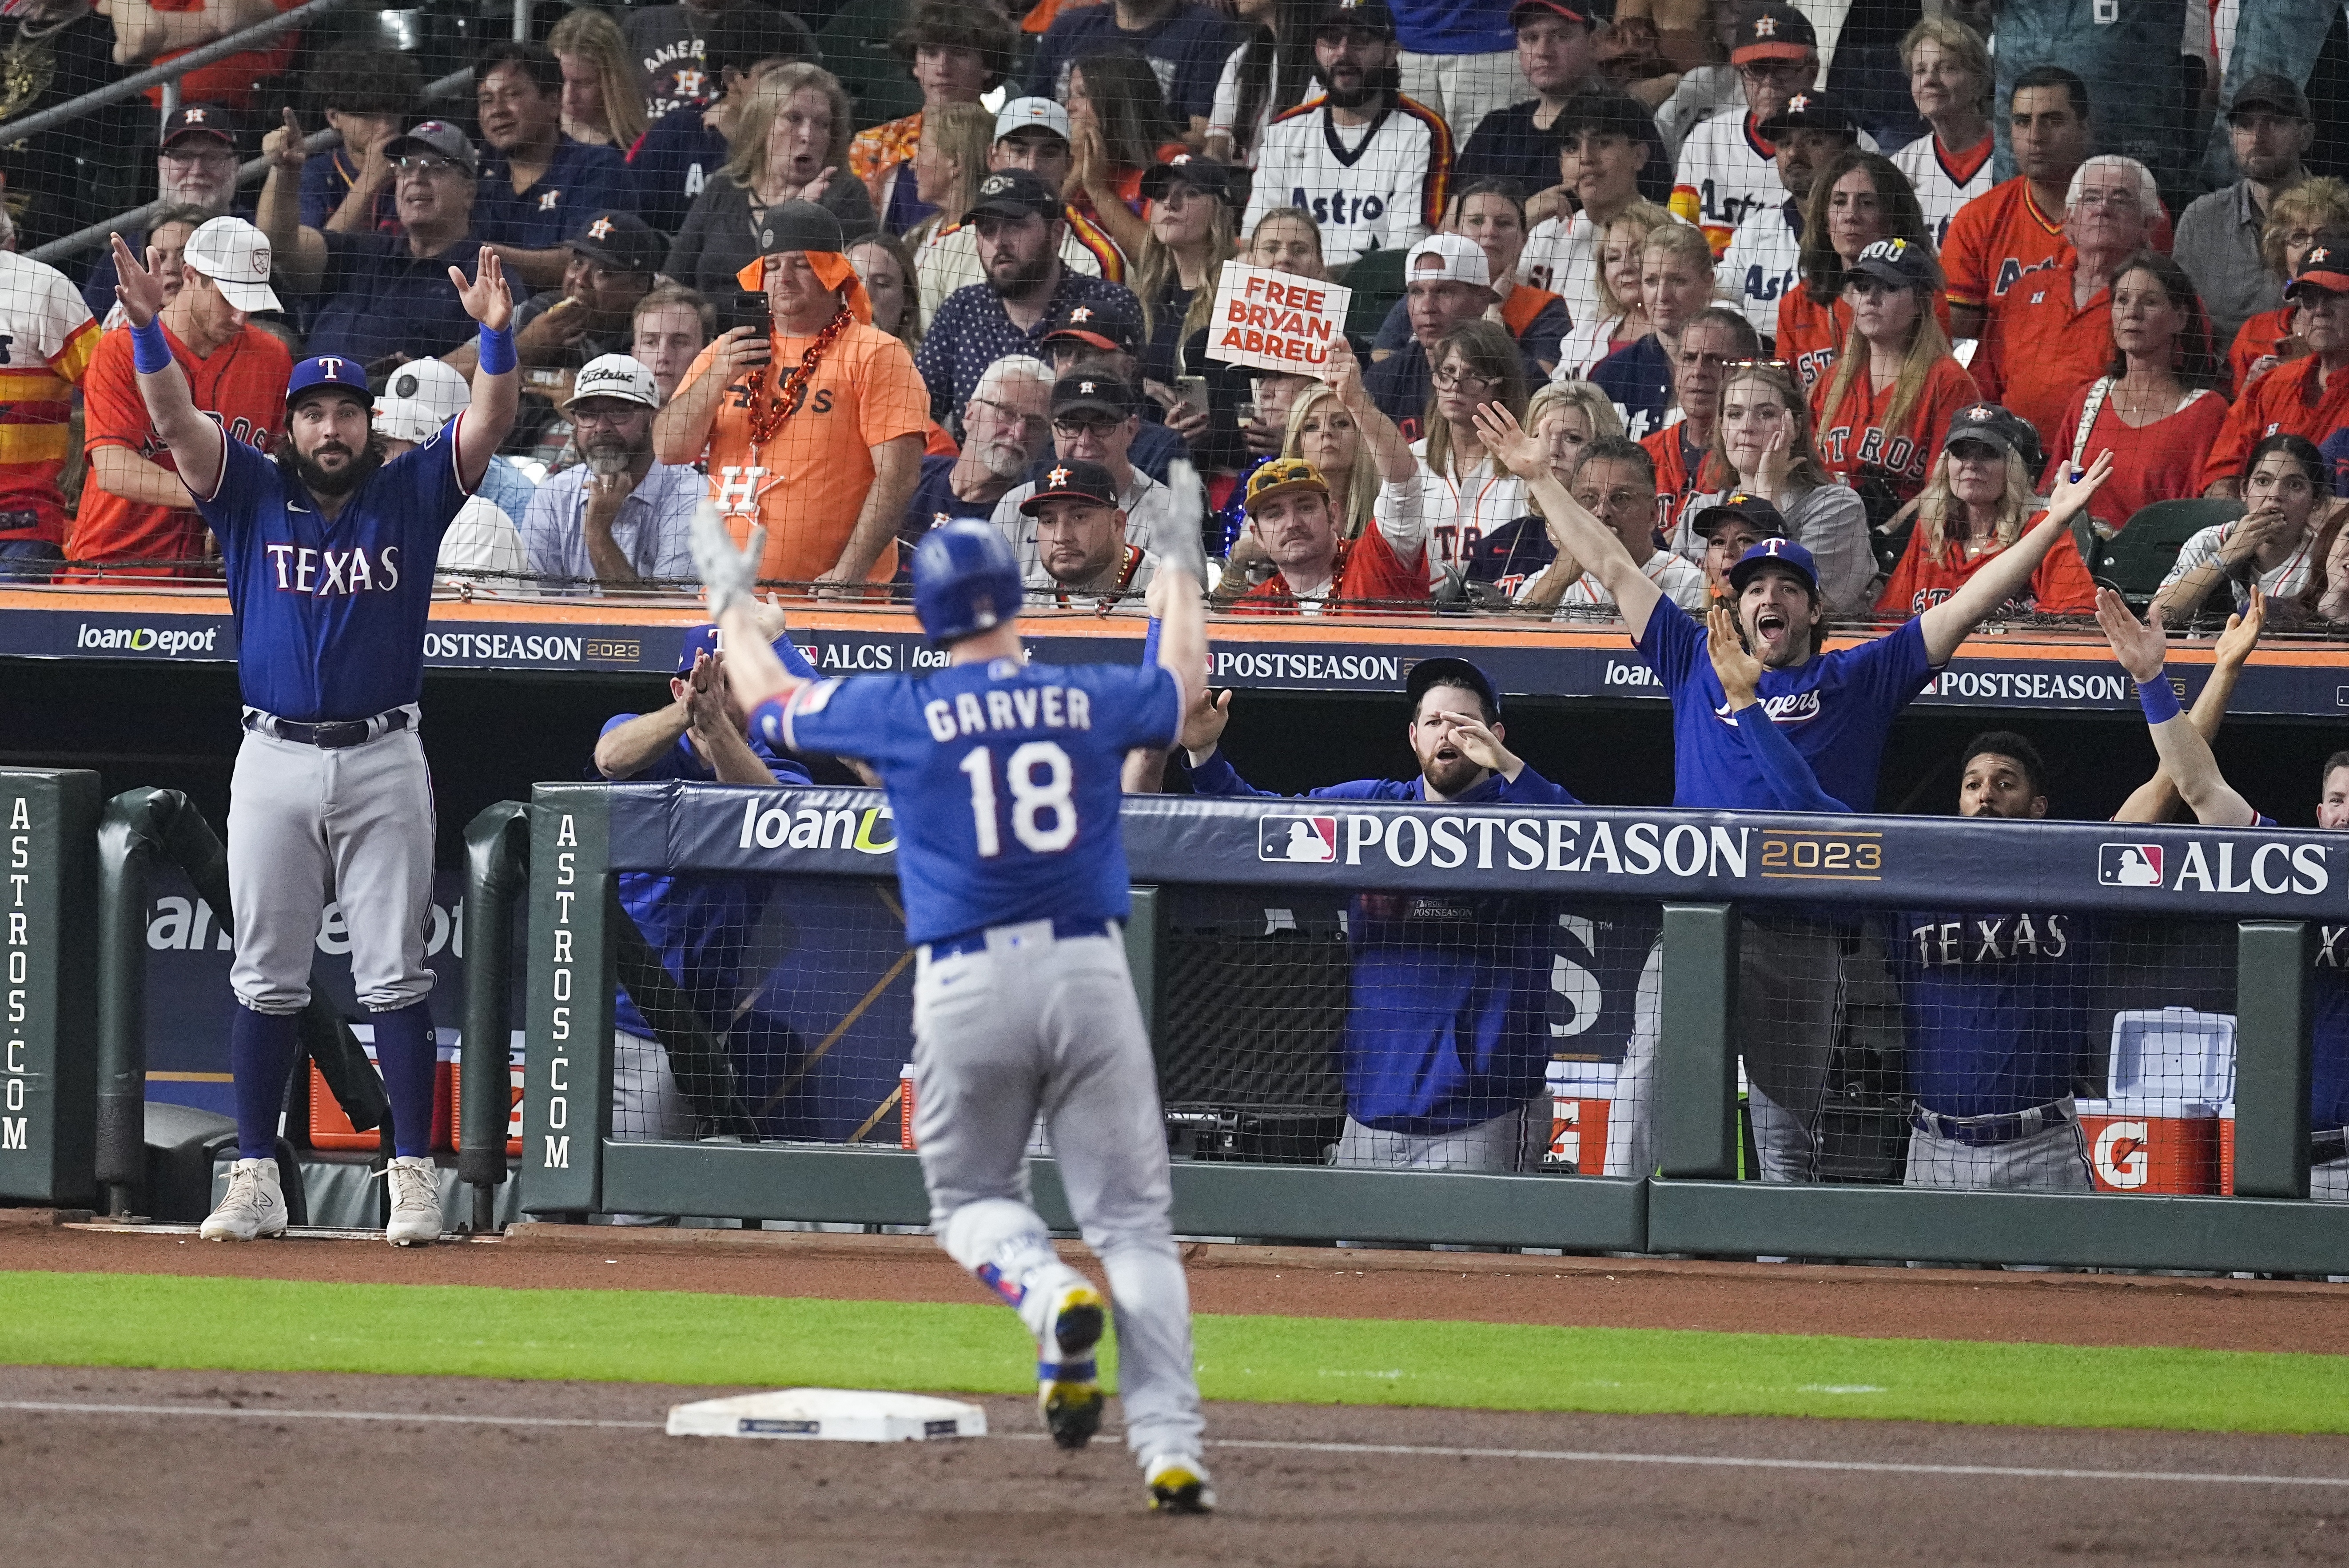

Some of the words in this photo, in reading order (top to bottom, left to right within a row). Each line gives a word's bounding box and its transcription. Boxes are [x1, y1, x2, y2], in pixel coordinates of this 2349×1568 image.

[644, 39, 705, 72] AMER
[1292, 187, 1393, 225] Astro
[1245, 276, 1326, 314] FREE
[1228, 300, 1332, 341] BRYAN
[1220, 327, 1326, 365] ABREU
[319, 358, 342, 379] T
[578, 368, 635, 390] Titleist
[1824, 426, 1929, 481] TROS
[1761, 538, 1786, 556] T
[267, 545, 399, 596] TEXAS
[77, 624, 217, 655] loanDepot
[587, 644, 640, 658] 2023
[822, 644, 892, 669] ALCS
[1218, 653, 1398, 681] POSTSEASON
[1942, 672, 2125, 700] POSTSEASON
[924, 685, 1091, 743] GARVER
[959, 741, 1079, 858] 18
[1346, 814, 1749, 878] POSTSEASON
[1762, 841, 1882, 870] 2023
[2172, 841, 2329, 895] ALCS
[1413, 907, 1473, 919] POSTSEASON
[1912, 913, 2069, 969] TEXAS
